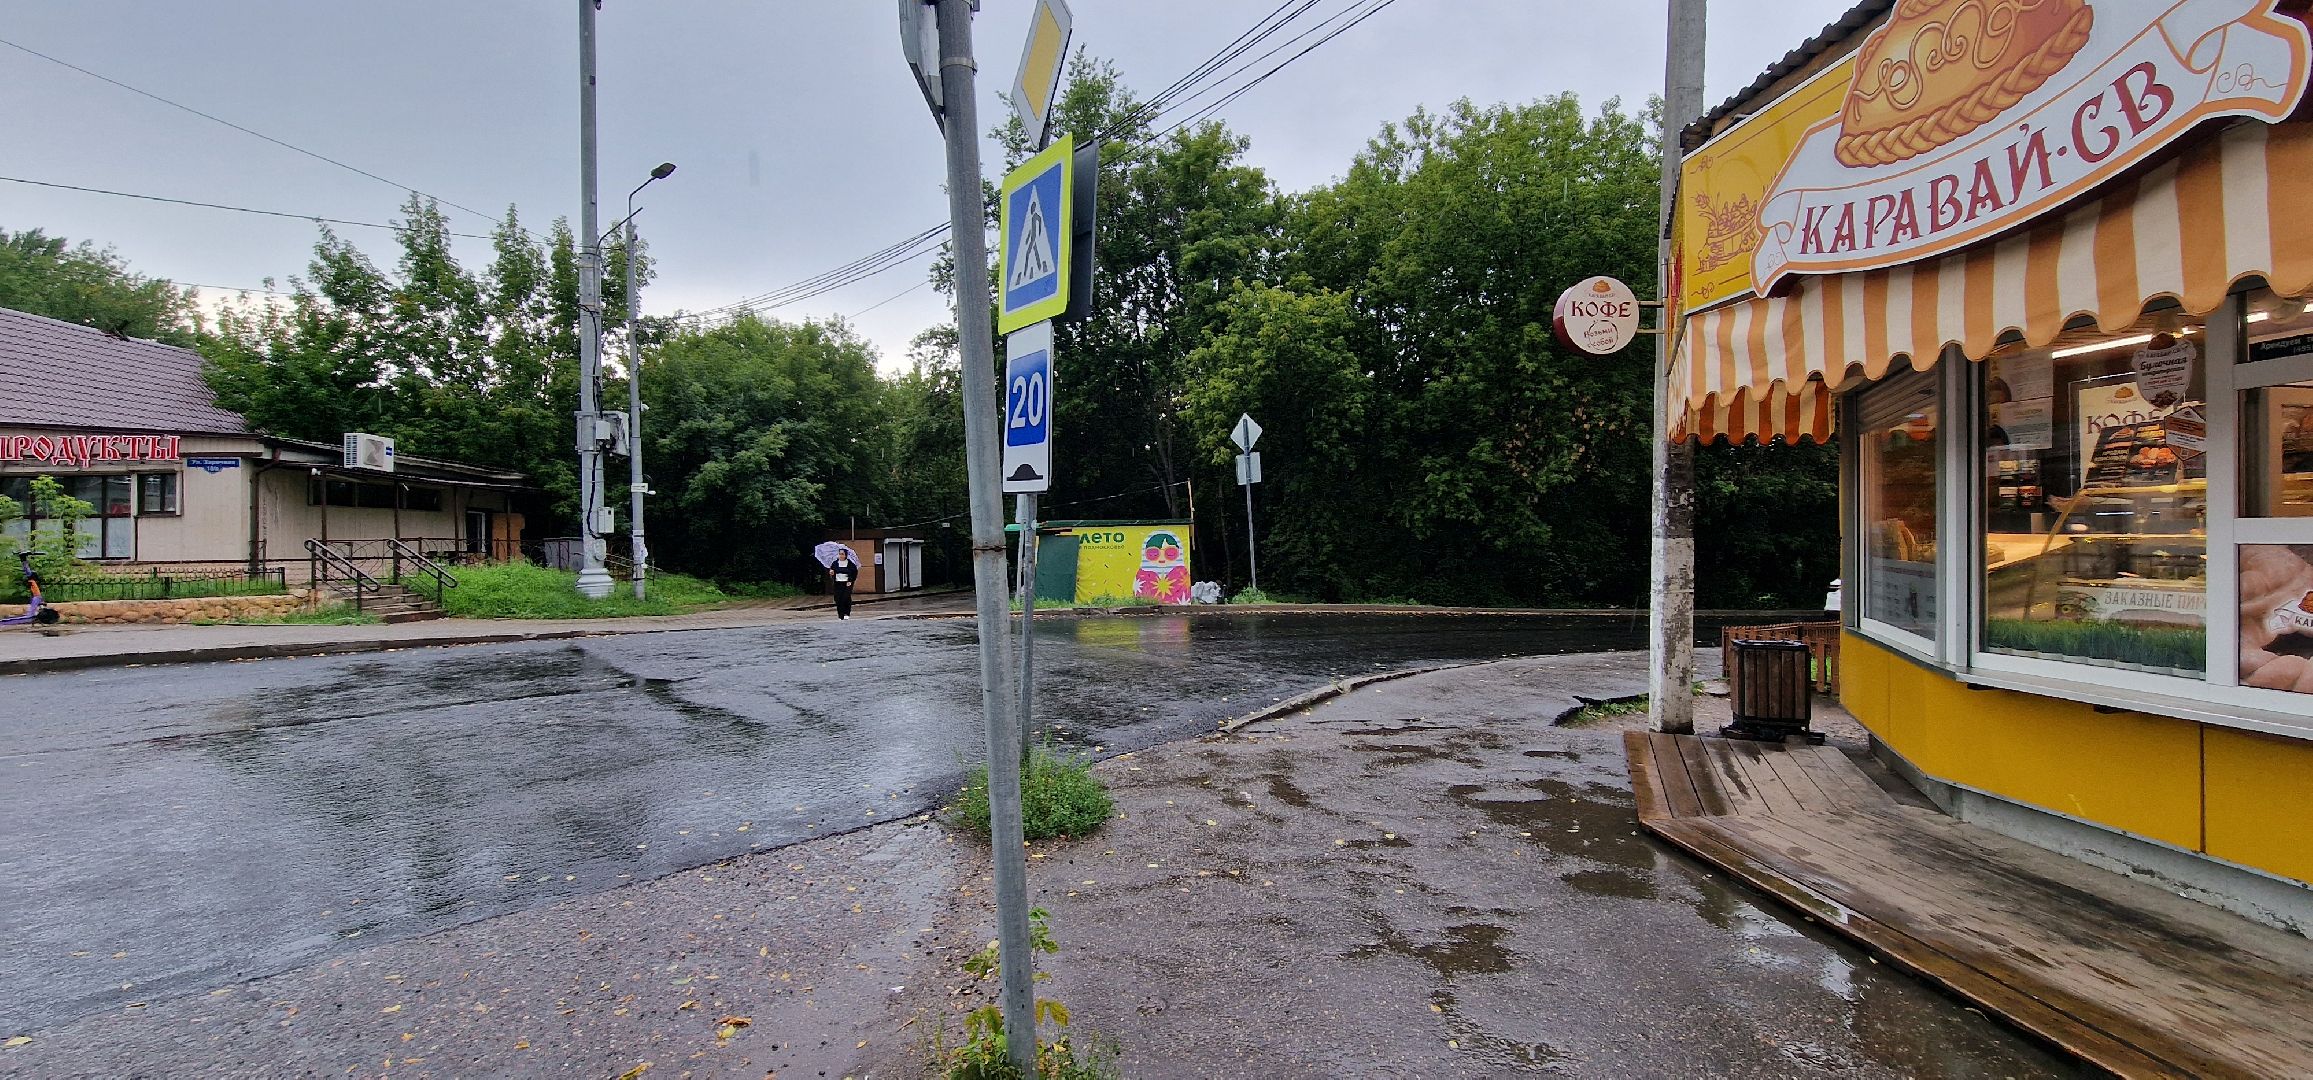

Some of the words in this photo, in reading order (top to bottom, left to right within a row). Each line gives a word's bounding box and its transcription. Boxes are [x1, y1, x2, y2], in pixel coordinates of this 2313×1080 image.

[1571, 300, 1632, 318] КОФЕ
[2140, 357, 2188, 371] Булочная
[1010, 371, 1044, 429] 20
[2104, 591, 2174, 609] ЗАКАЗНЫЕ
